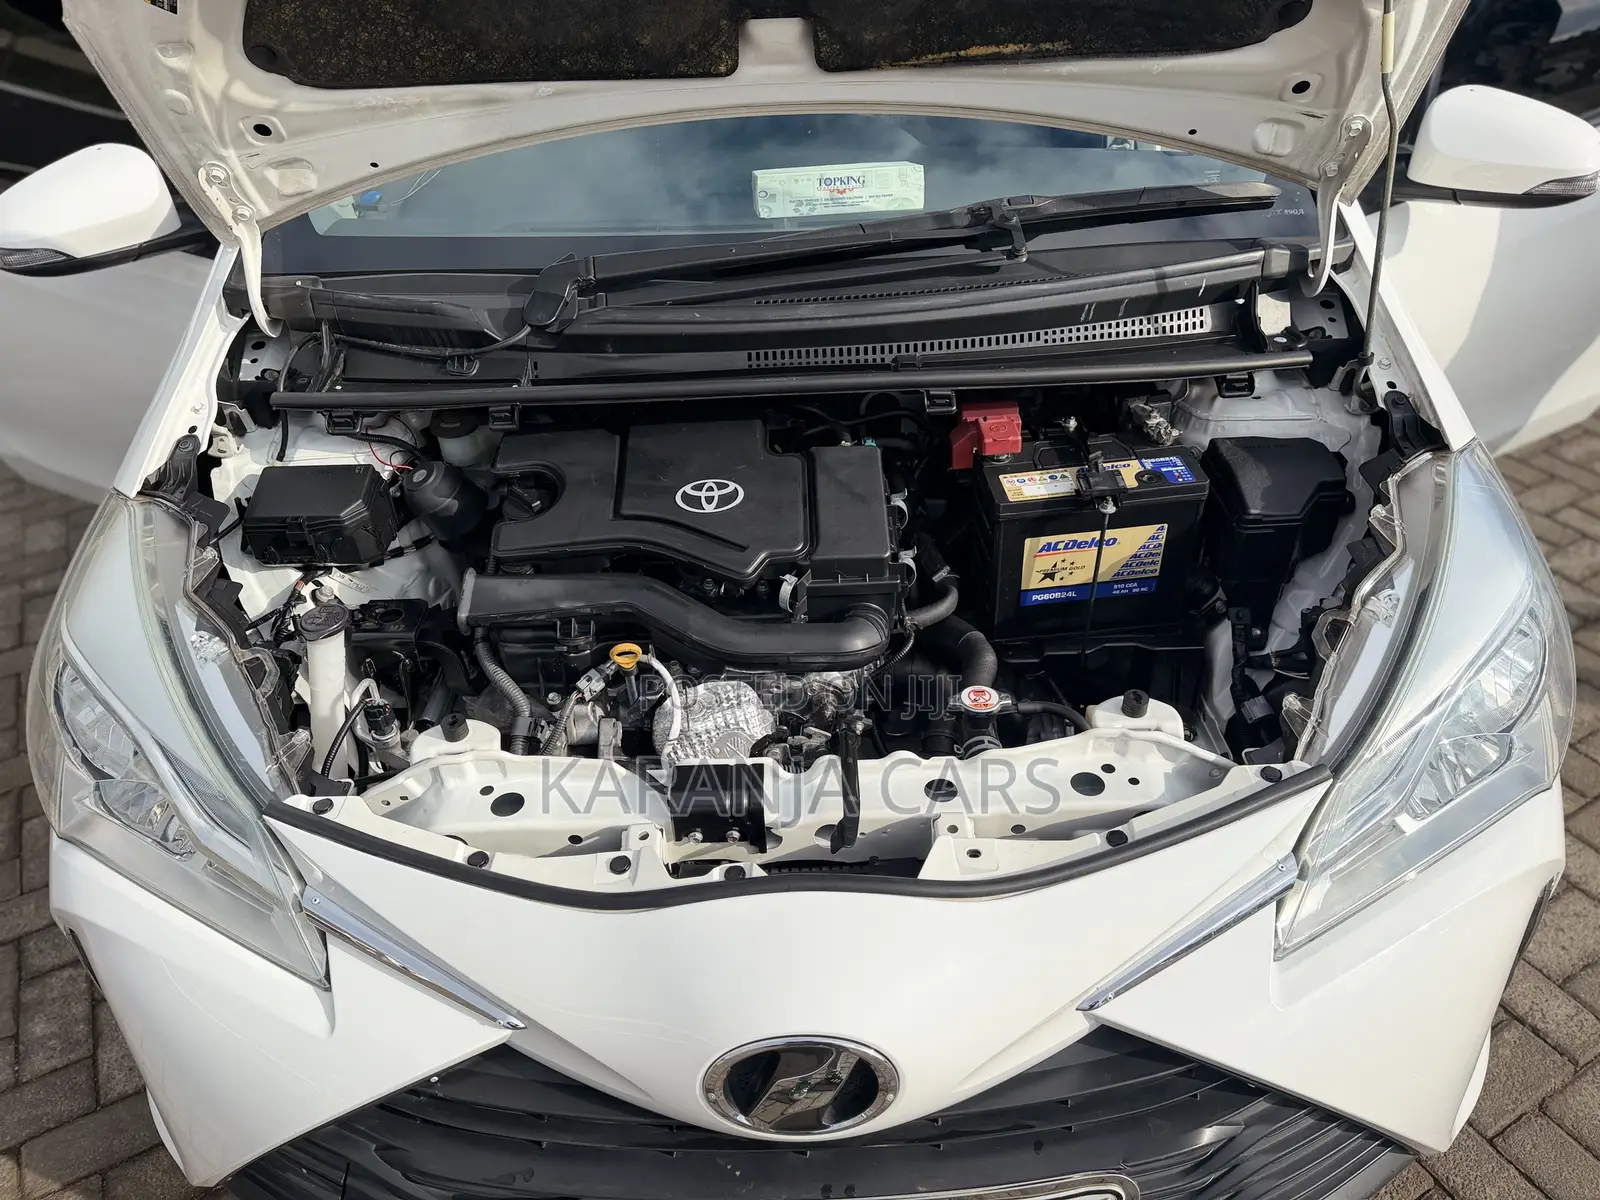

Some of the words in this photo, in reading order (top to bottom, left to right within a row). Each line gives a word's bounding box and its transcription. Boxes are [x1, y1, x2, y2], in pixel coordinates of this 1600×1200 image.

[816, 175, 866, 186] TOPKING
[1037, 537, 1118, 554] ACDelco
[1112, 568, 1158, 578] ACDelco
[1032, 591, 1077, 601] PG60B24L
